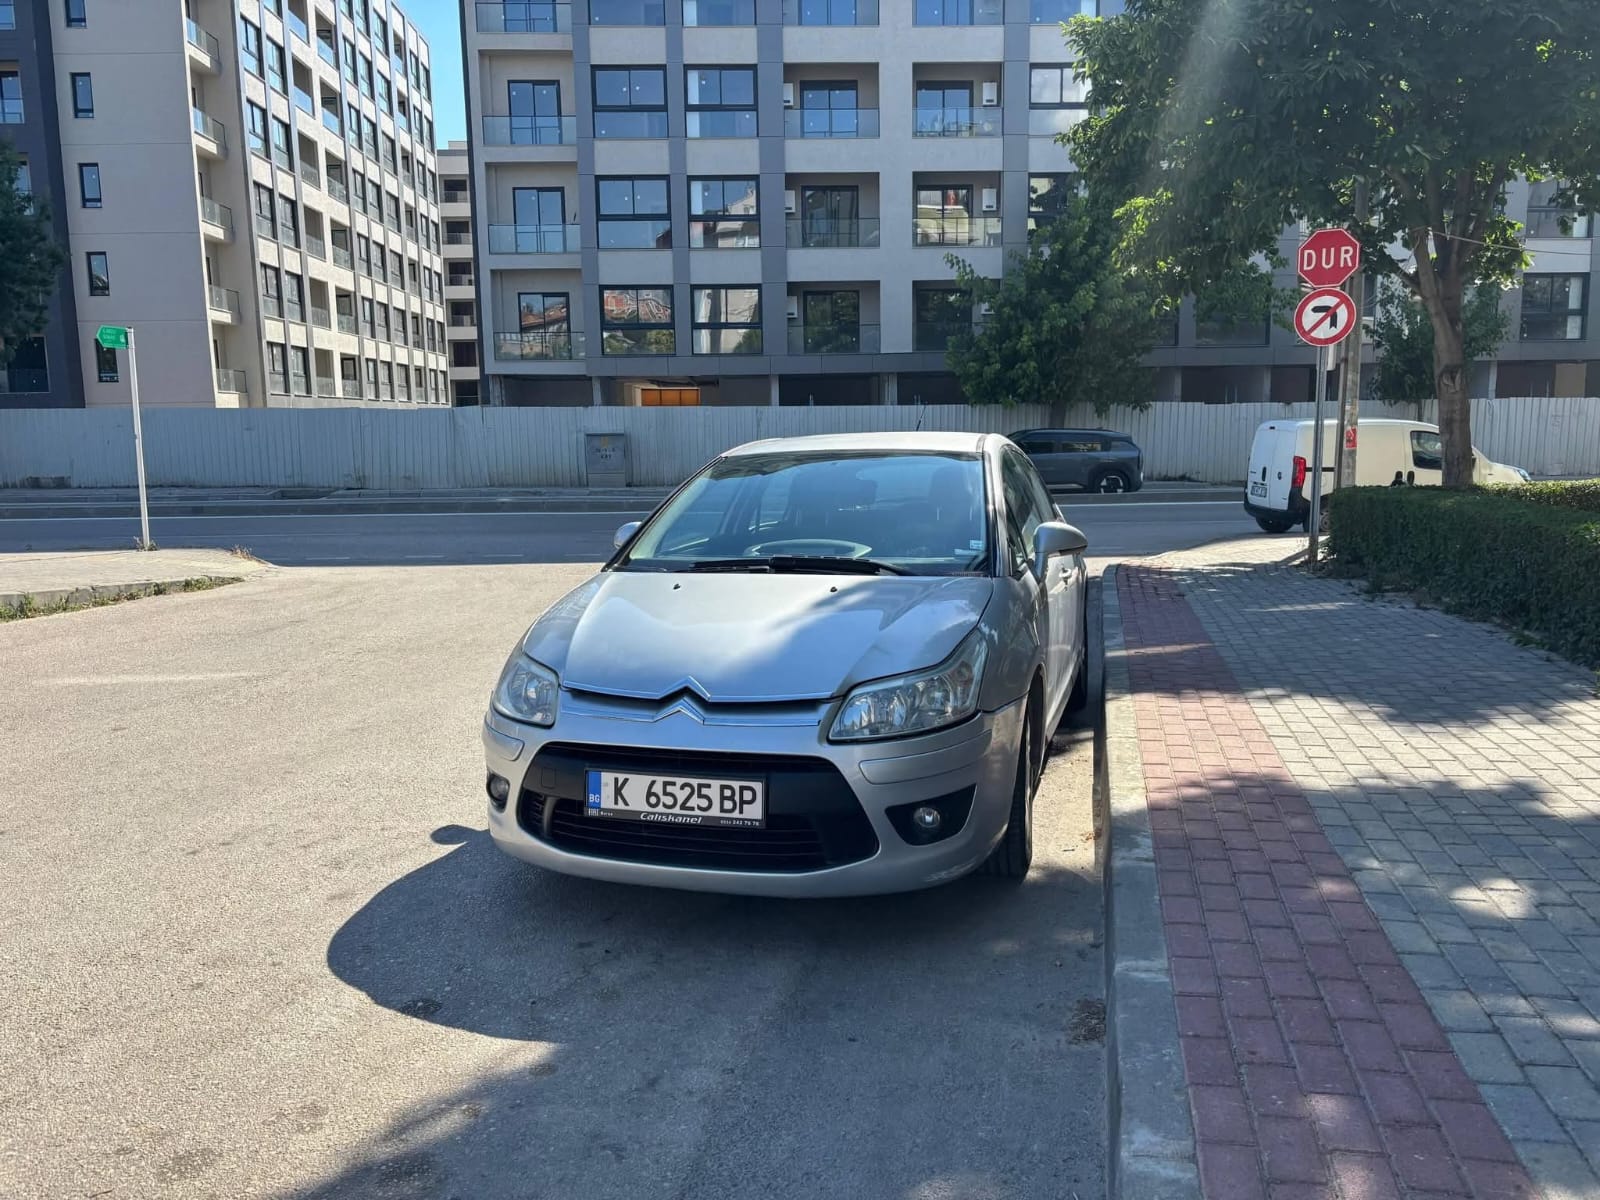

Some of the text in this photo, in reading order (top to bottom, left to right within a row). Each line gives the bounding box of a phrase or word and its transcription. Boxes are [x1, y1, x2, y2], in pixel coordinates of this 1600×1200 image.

[1303, 245, 1354, 271] DUR
[589, 794, 600, 803] BG
[613, 777, 630, 807] K
